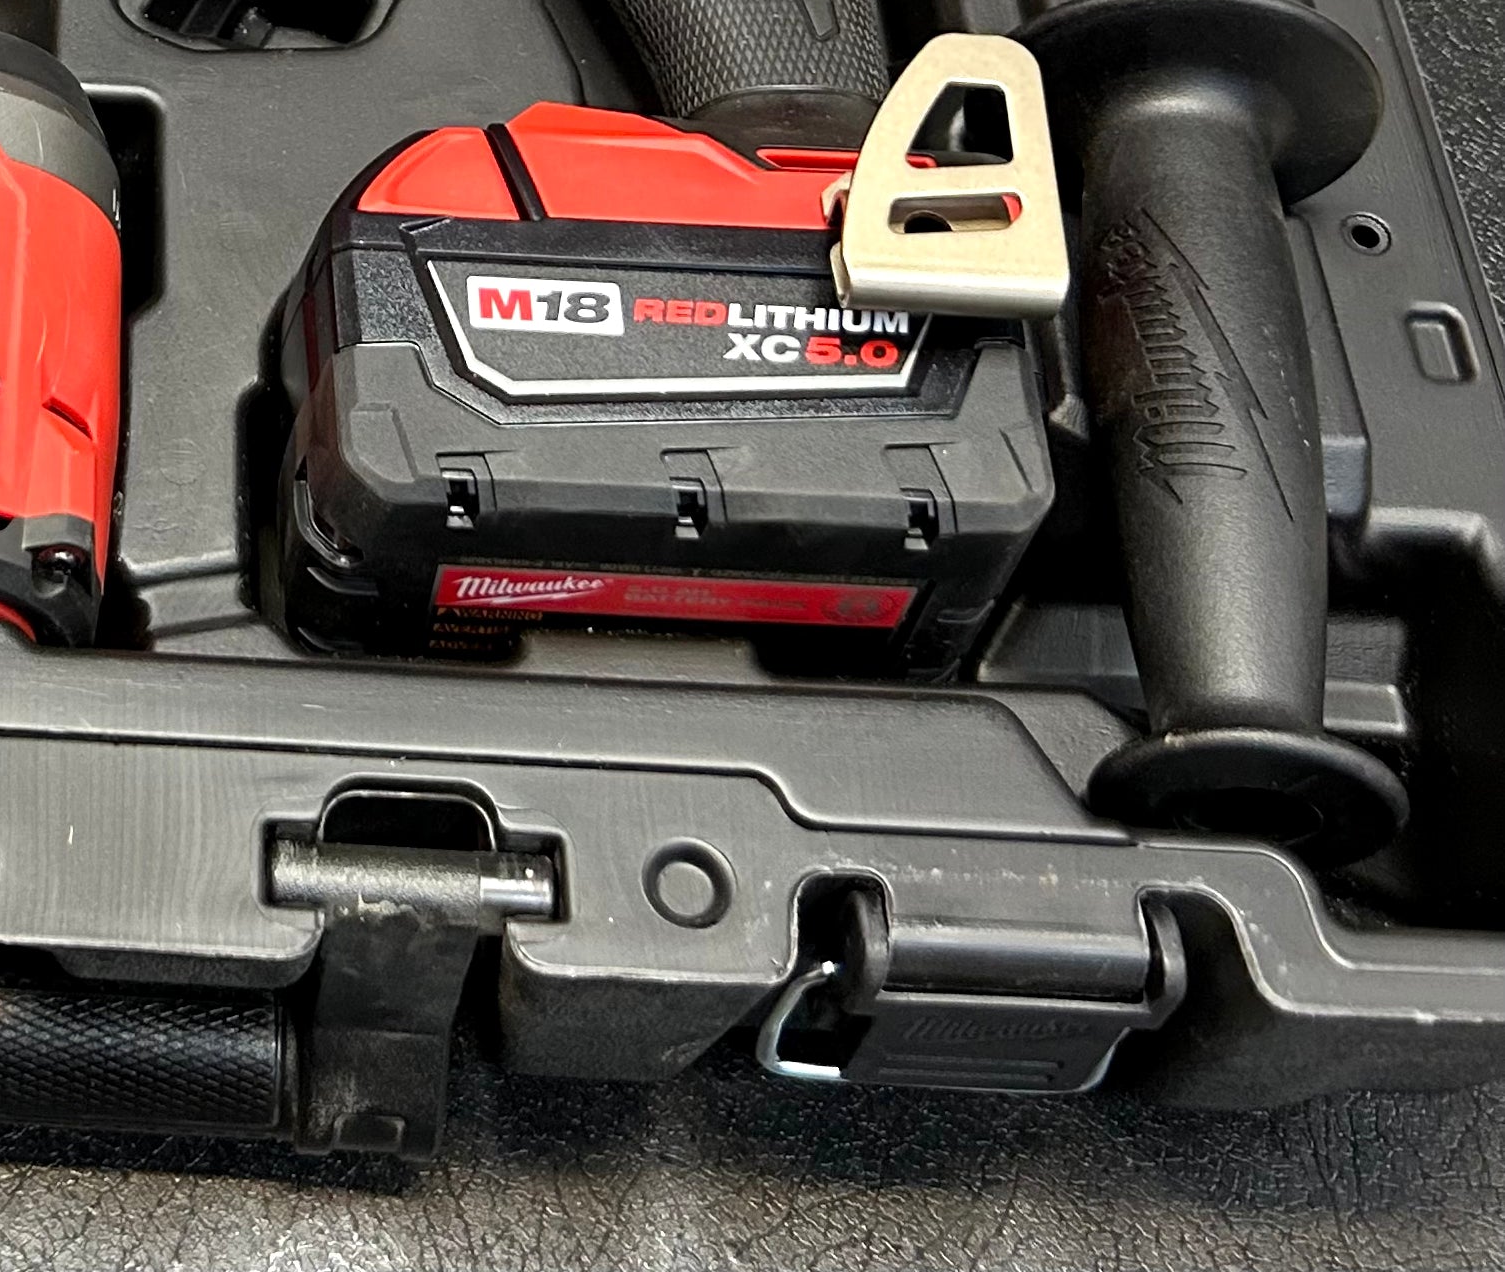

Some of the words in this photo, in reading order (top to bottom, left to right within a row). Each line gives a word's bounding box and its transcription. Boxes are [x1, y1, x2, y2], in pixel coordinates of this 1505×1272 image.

[478, 287, 611, 324] M18
[723, 332, 899, 368] XC5.0
[452, 575, 605, 599] Milwaukee
